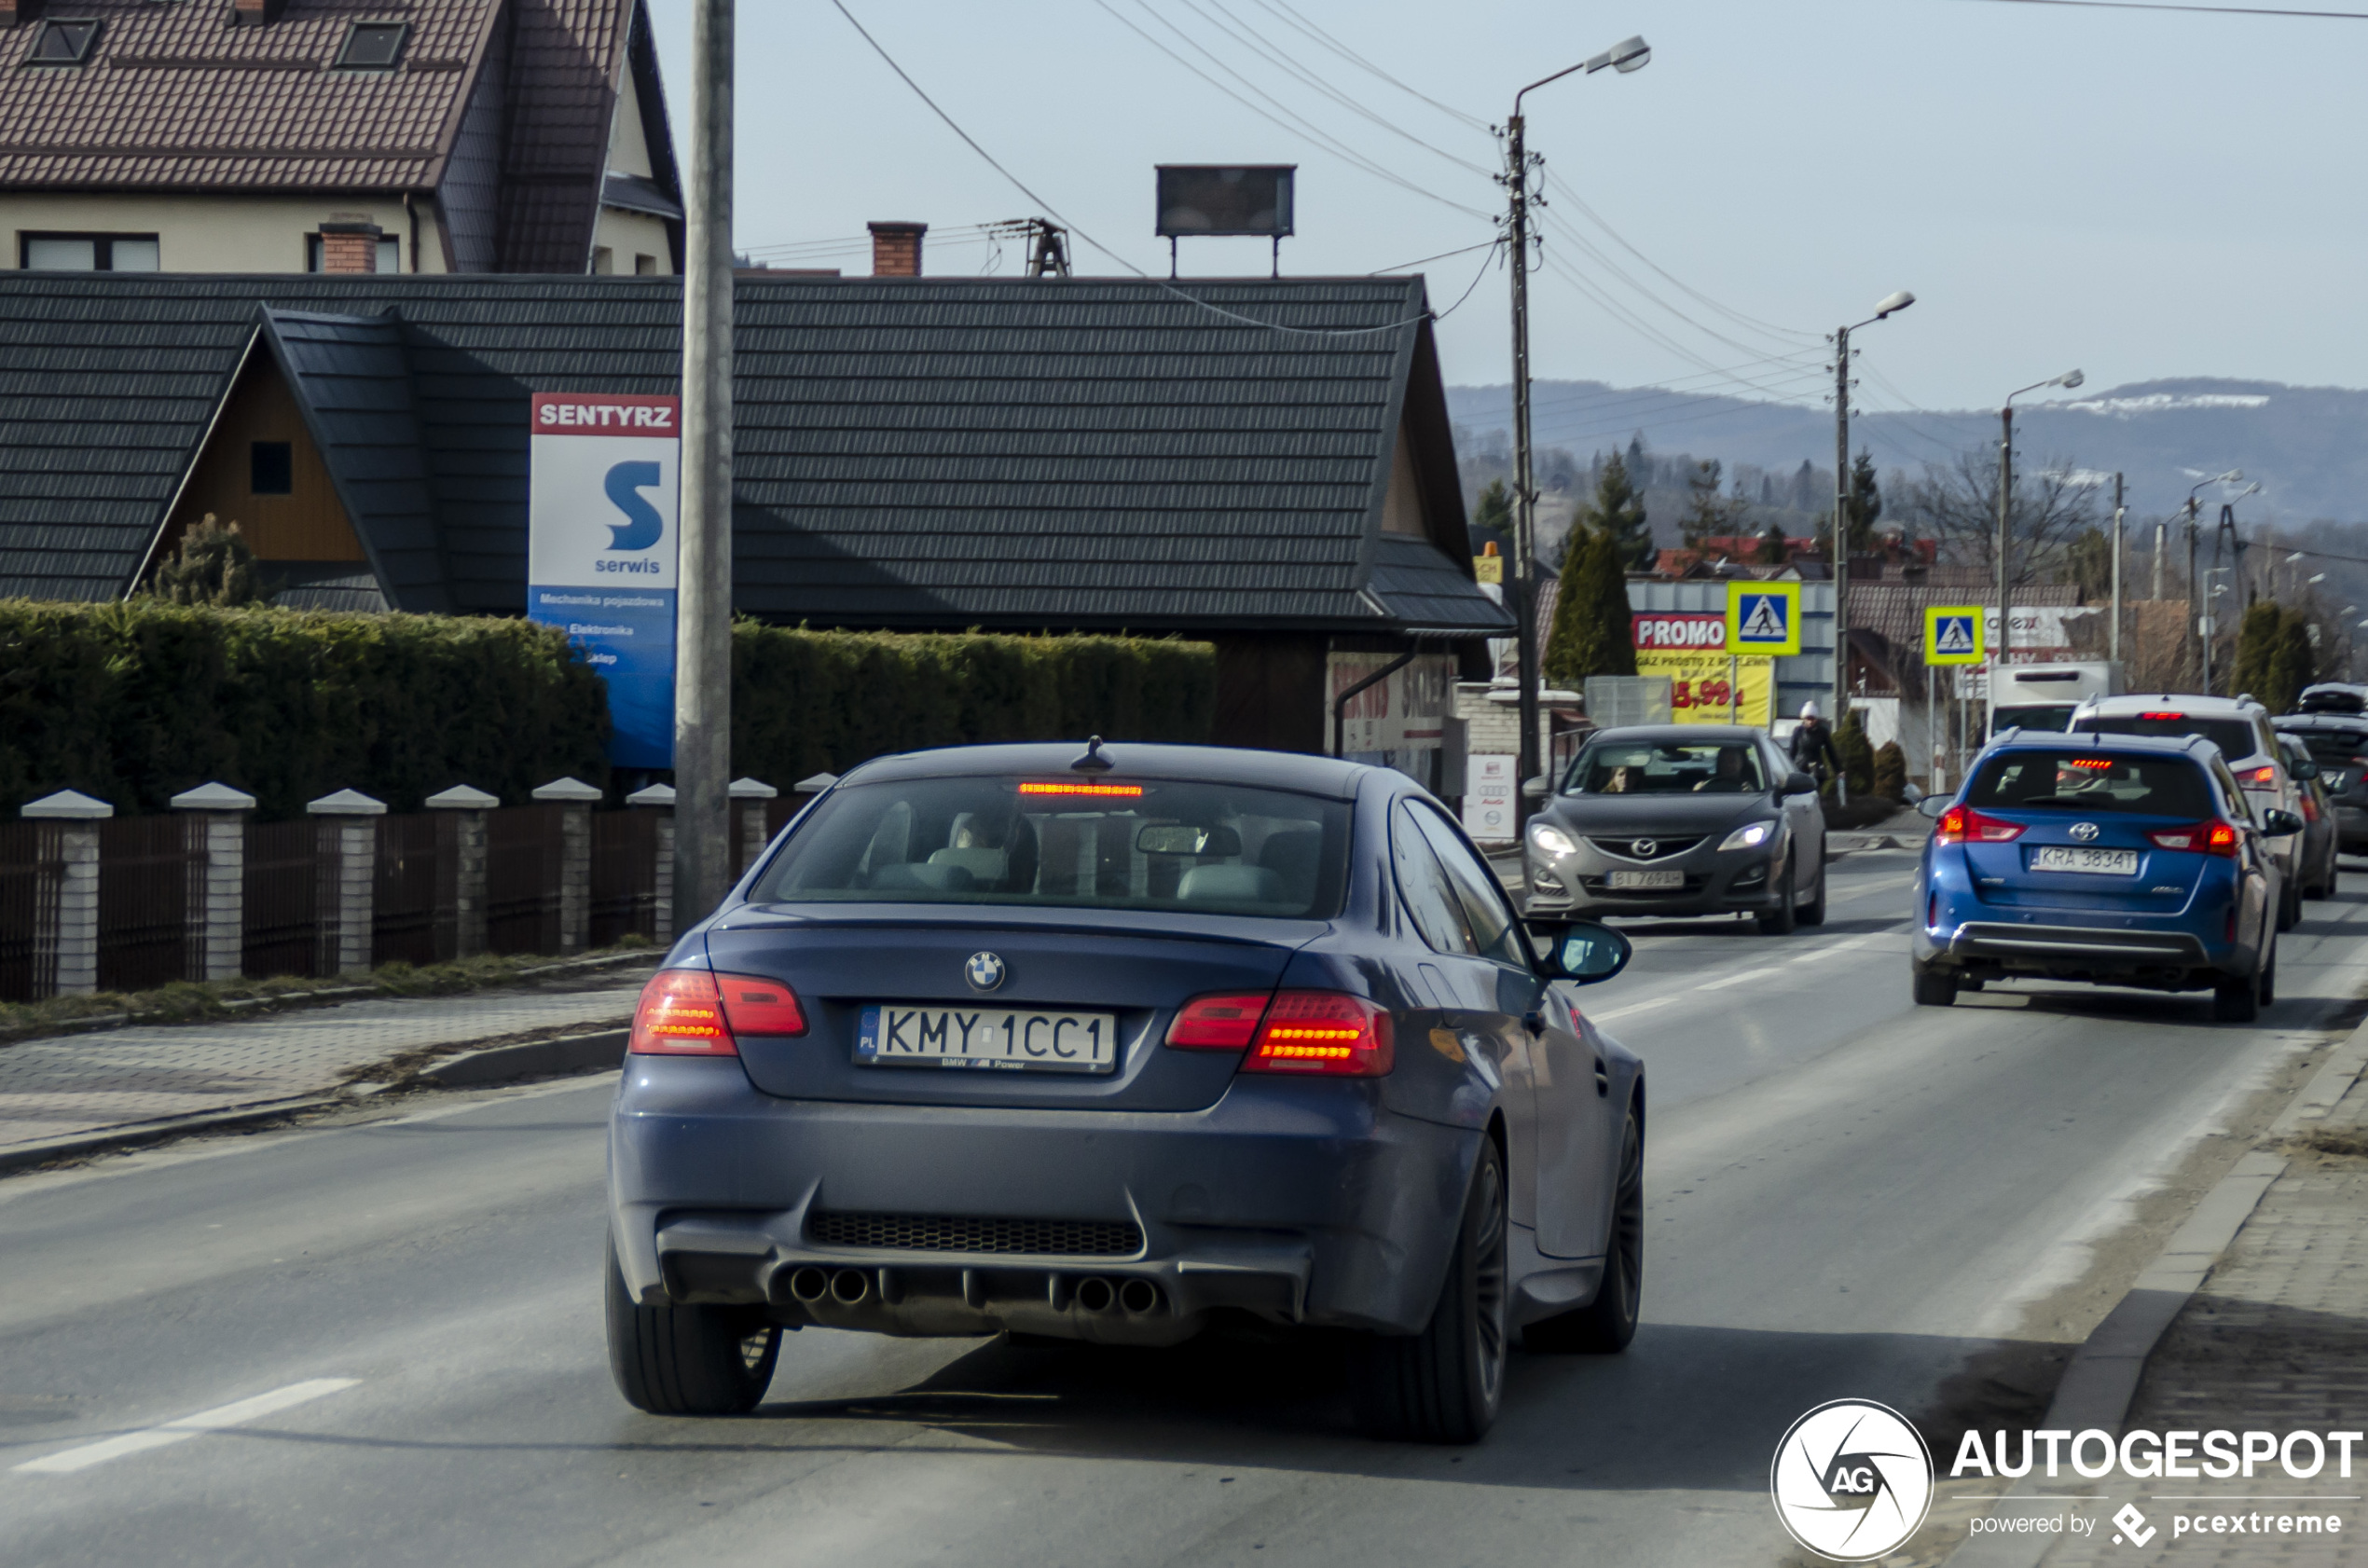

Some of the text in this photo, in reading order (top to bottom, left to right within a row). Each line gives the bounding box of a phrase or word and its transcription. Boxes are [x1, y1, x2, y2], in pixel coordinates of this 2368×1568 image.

[540, 404, 672, 427] SENTYRZ
[595, 557, 660, 574] serwis
[540, 593, 664, 607] Mechanika pojazdowa
[570, 623, 634, 636] Elektronika
[1638, 620, 1725, 646] PROMO
[2042, 847, 2135, 869] KRA 3834T
[970, 953, 1001, 968] BMW
[860, 1037, 875, 1050] PL
[886, 1011, 1102, 1060] KMY 1CC1
[942, 1057, 967, 1067] BMW
[995, 1059, 1025, 1069] Power
